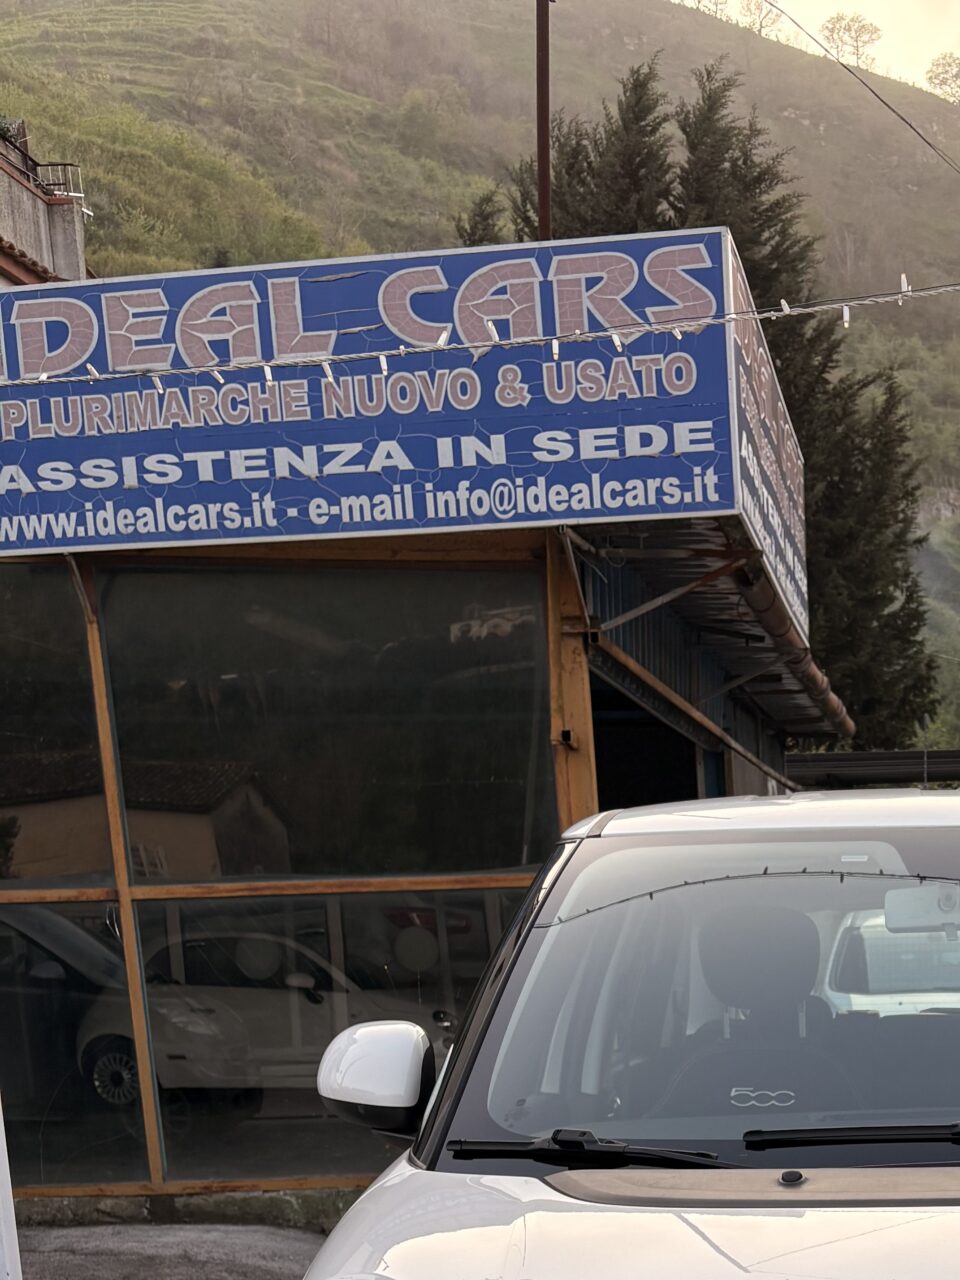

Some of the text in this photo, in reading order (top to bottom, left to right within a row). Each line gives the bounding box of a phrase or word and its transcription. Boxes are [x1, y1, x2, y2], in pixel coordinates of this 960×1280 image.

[0, 243, 717, 381] DEAL CARS
[1, 352, 697, 441] PLURIMARCHE NUOVO & USATO
[0, 421, 715, 496] ASSISTENZA IN SEDE
[0, 491, 278, 542] www.idealcars.it
[308, 483, 415, 525] e-mail
[425, 467, 719, 520] info@idealcars.it
[730, 1087, 796, 1107] 500
